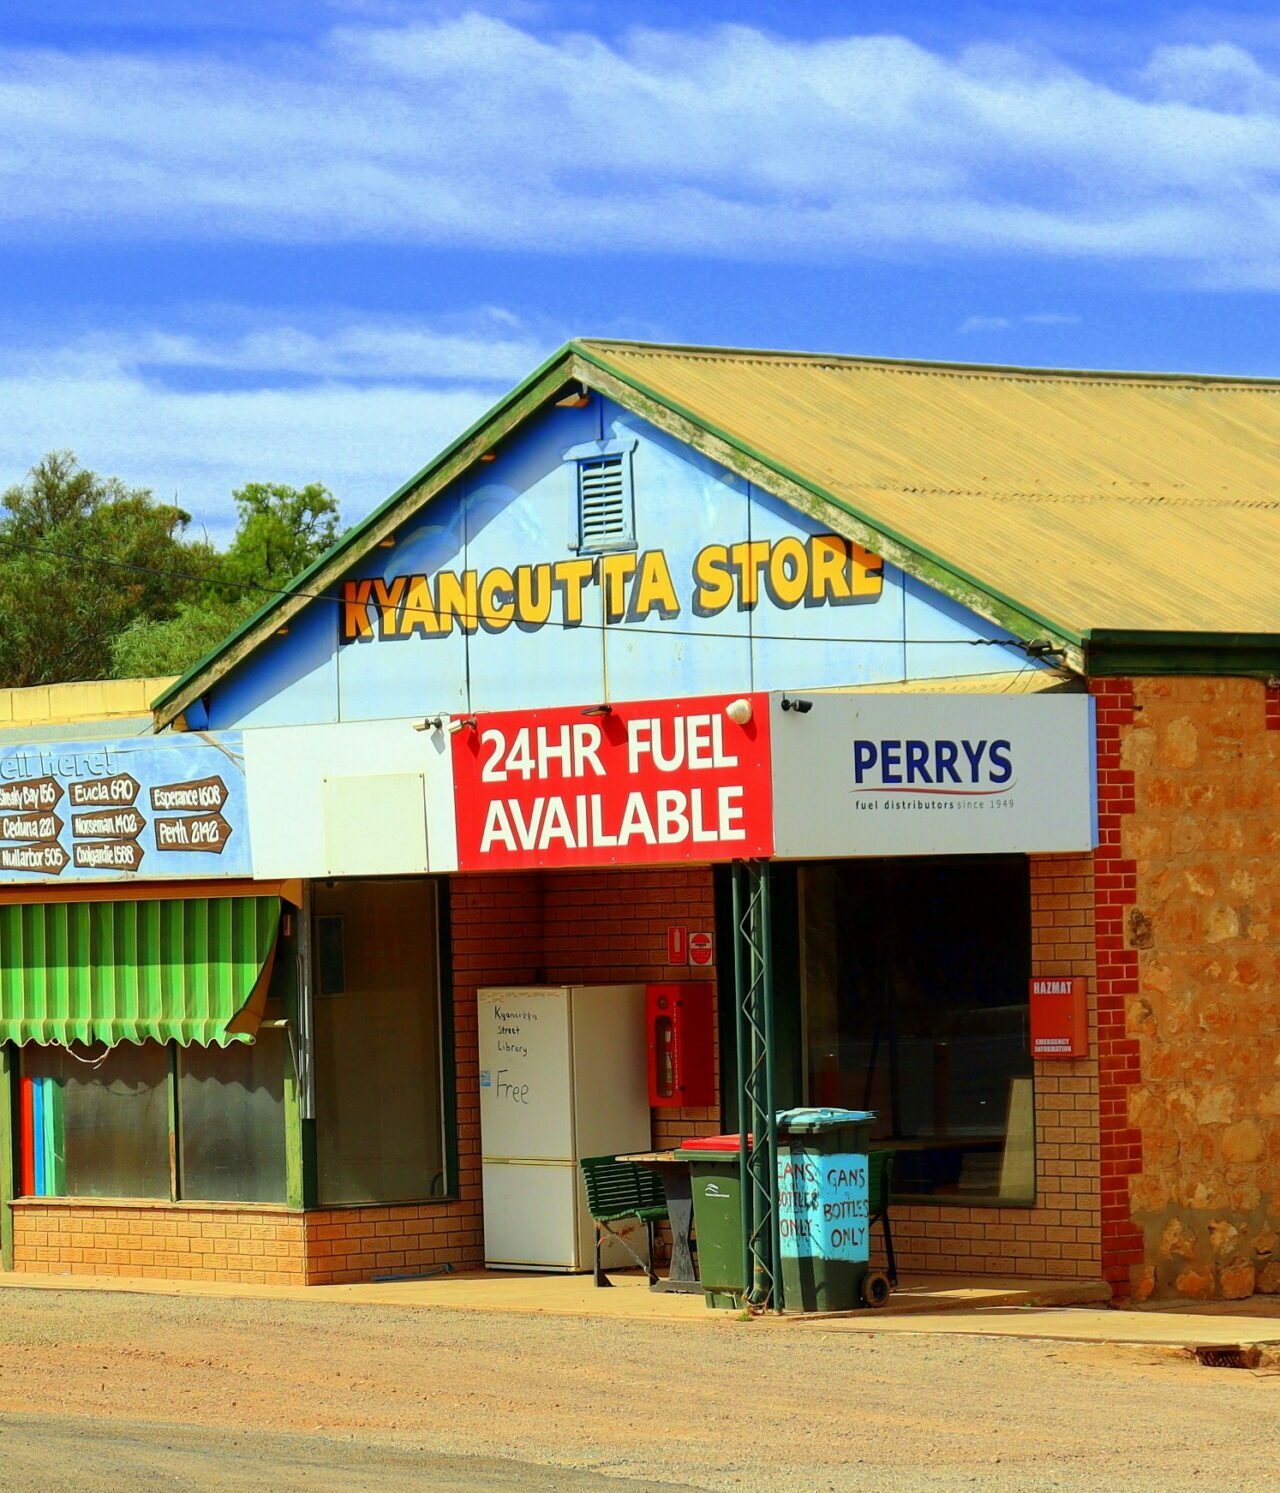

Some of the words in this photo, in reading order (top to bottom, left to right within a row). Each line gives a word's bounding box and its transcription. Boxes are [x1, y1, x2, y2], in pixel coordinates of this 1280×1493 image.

[340, 551, 680, 645] KYANCUTTA
[693, 533, 885, 618] STORE
[481, 723, 607, 783] 24HR
[627, 714, 738, 774] FUEL
[854, 740, 1013, 783] PERRYS
[23, 786, 39, 809] Bay
[40, 783, 55, 803] 156
[75, 783, 109, 802] Eucla
[154, 788, 198, 809] Esperance
[199, 785, 221, 806] 1608
[856, 800, 878, 810] fuel
[884, 800, 954, 810] distributors
[957, 800, 984, 809] since
[990, 799, 1014, 808] 1949
[3, 817, 38, 838] Ceduna
[39, 817, 55, 836] 221
[75, 816, 114, 834] Norseman
[480, 786, 746, 853] AVAILABLE
[160, 819, 189, 844] Perth
[191, 820, 219, 844] 2142
[2, 848, 44, 867] Nullarbor
[45, 848, 63, 867] 505
[76, 845, 113, 866] Coolgardie
[114, 845, 134, 864] 1588
[1034, 982, 1072, 995] HAZMAT
[498, 1026, 520, 1034] Street
[498, 1041, 527, 1056] Library
[496, 1069, 529, 1104] Free
[823, 1200, 869, 1222] BOTTLES
[780, 1219, 812, 1237] ONLY
[831, 1227, 865, 1248] ONLY
